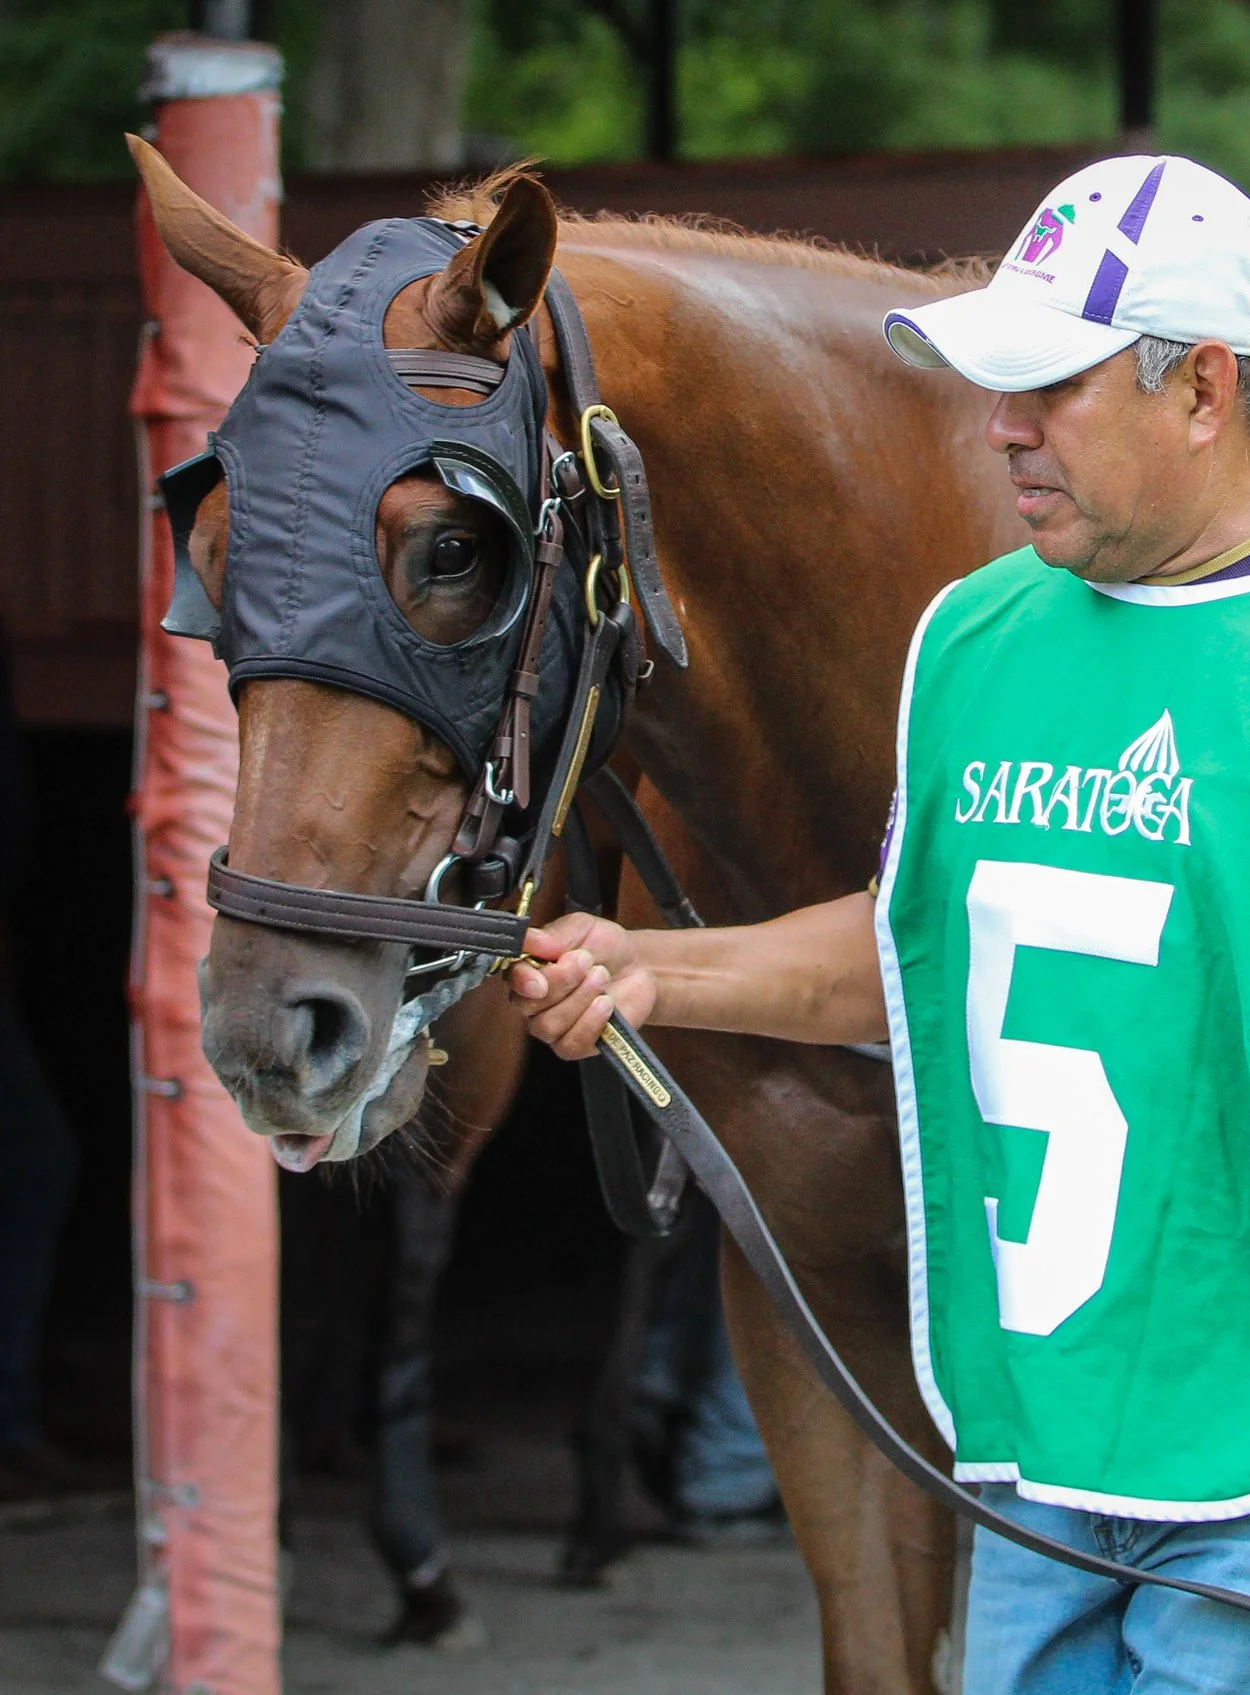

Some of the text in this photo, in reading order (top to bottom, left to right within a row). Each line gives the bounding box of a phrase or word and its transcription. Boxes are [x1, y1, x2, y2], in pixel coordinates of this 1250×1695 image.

[954, 760, 1194, 846] SARATOGA
[620, 1045, 636, 1064] PAZ
[966, 859, 1175, 1337] 5
